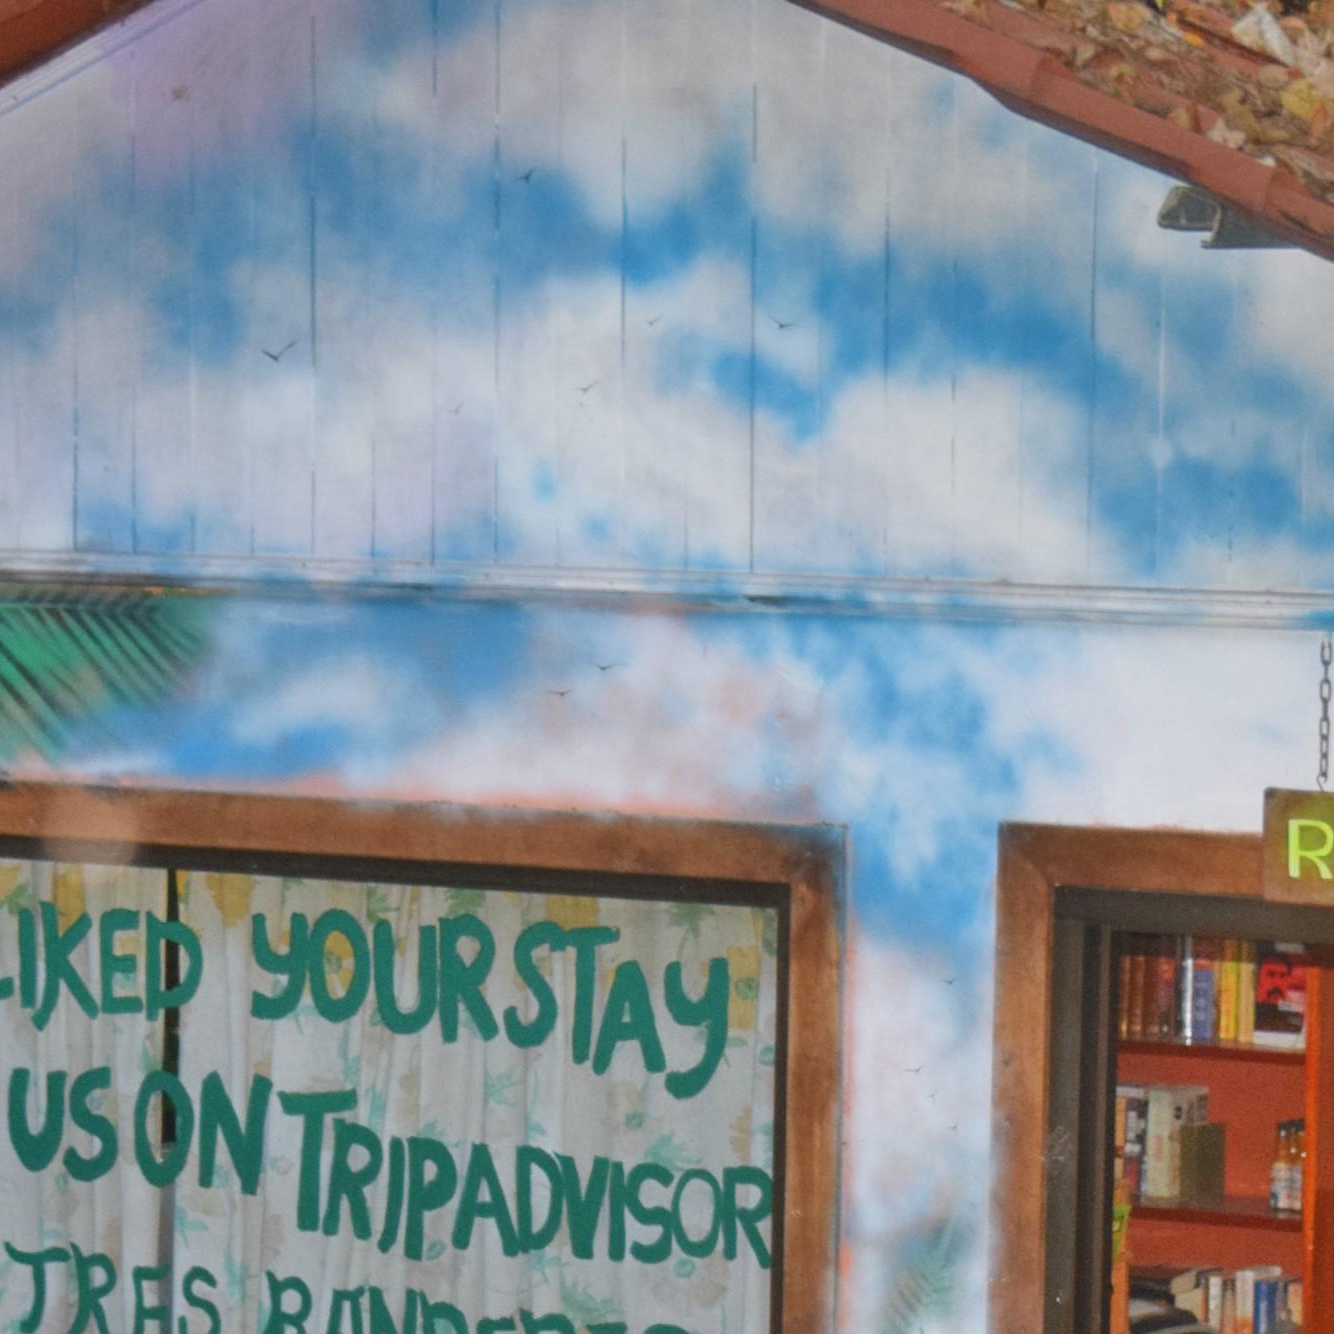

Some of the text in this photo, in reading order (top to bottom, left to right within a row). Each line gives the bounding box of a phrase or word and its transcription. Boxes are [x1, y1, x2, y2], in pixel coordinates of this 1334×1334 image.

[251, 908, 499, 1044] YOUR
[503, 920, 730, 1100] STAY
[8, 1066, 119, 1183] US
[134, 1068, 273, 1197] ON
[277, 1089, 773, 1269] TRIPADVISOR
